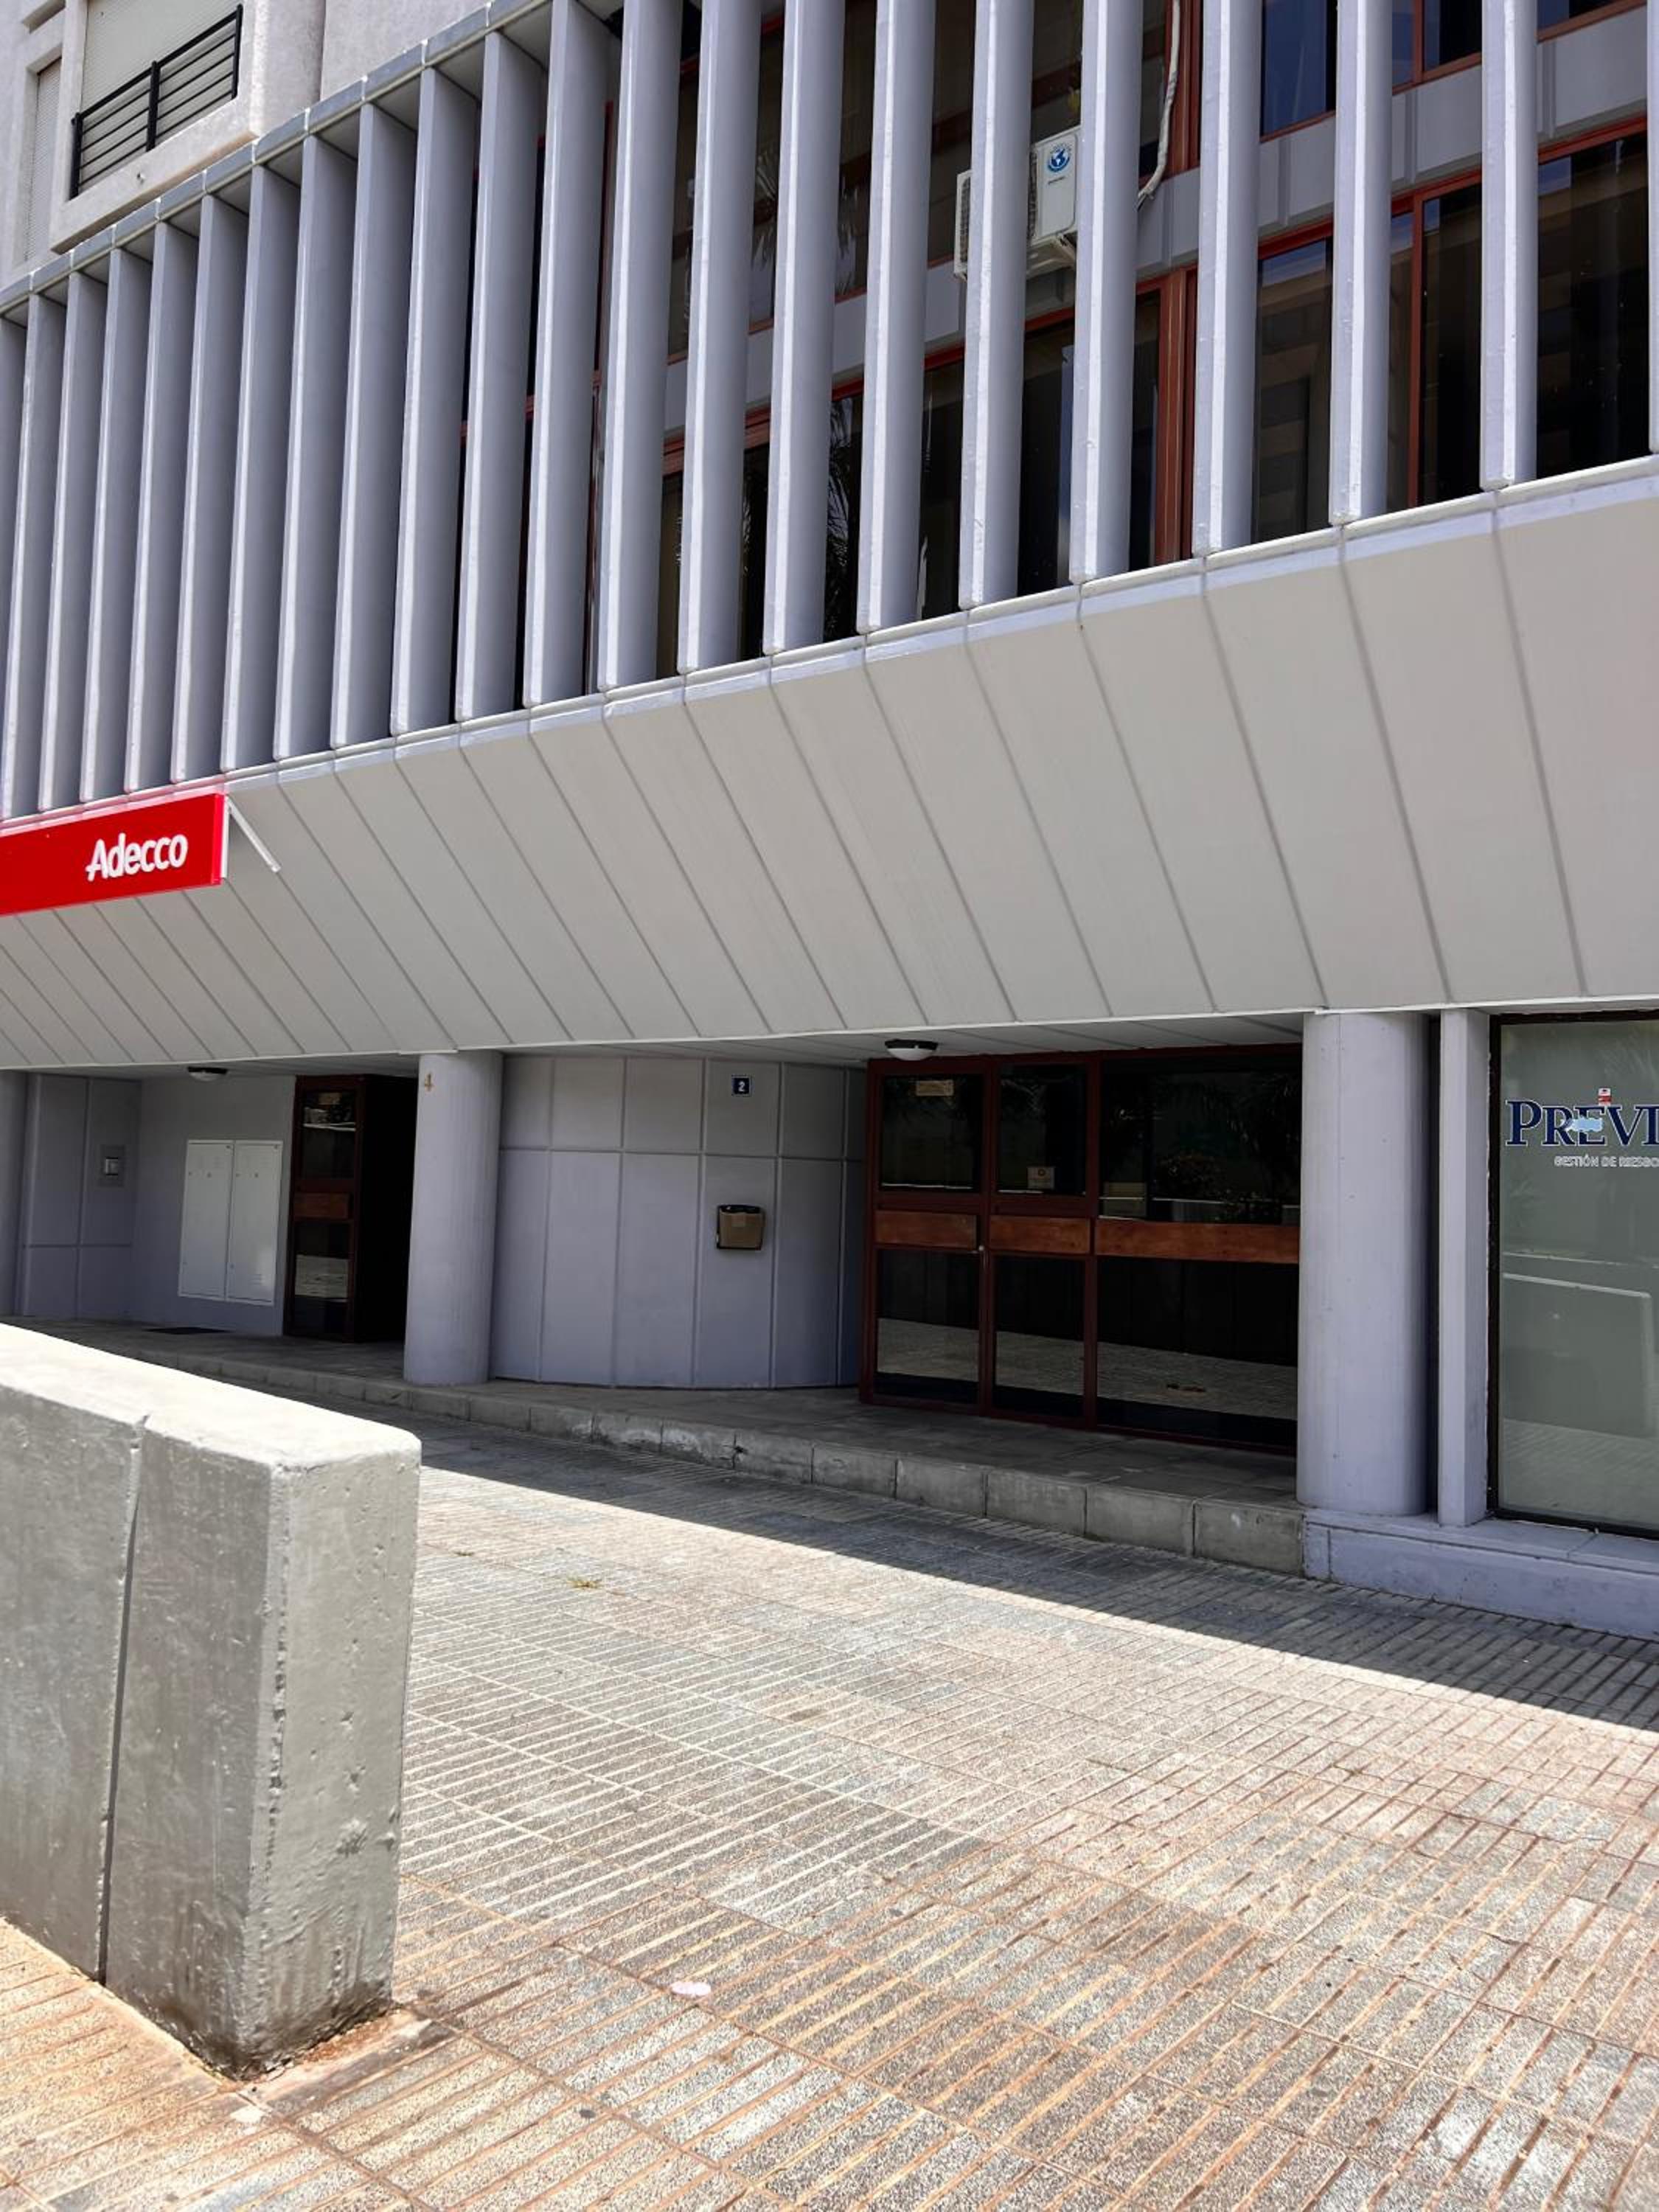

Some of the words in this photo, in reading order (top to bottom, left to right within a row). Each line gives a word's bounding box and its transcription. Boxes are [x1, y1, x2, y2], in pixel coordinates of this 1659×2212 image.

[86, 832, 188, 881] Adecco
[738, 1080, 746, 1092] 2
[1601, 1155, 1617, 1167] DE
